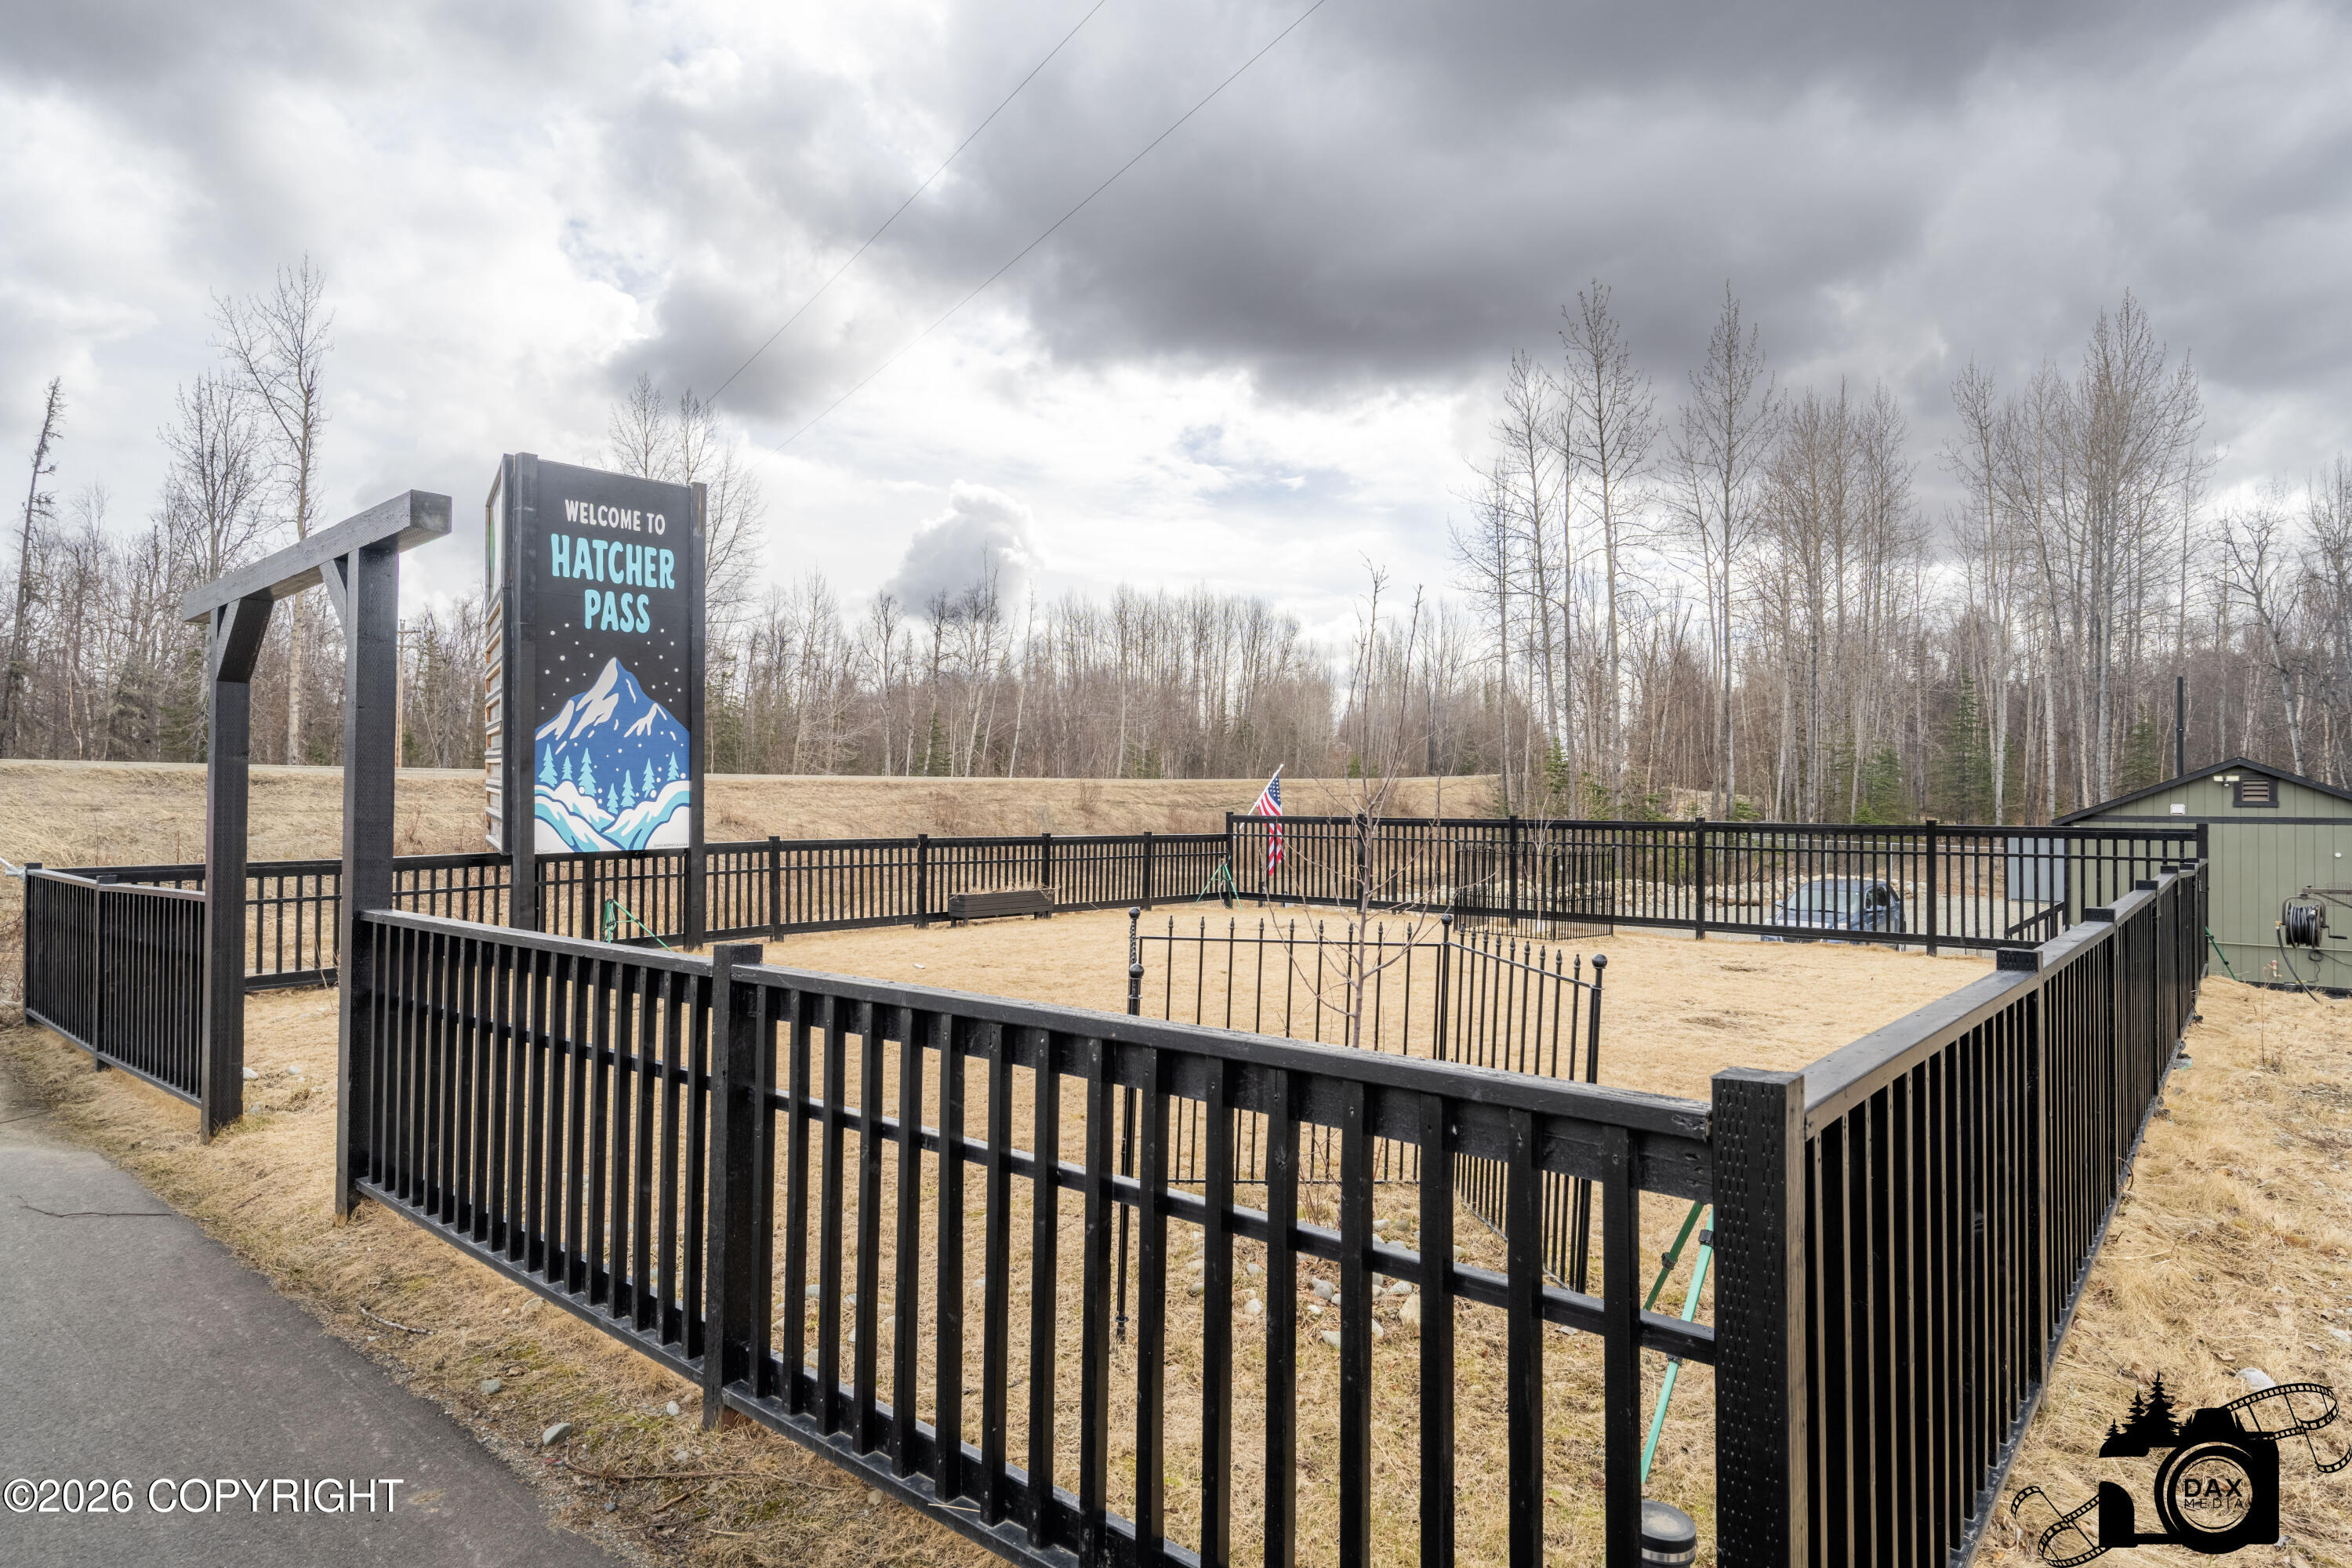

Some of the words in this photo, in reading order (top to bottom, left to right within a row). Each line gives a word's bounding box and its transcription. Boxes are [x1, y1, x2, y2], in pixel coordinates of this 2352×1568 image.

[564, 499, 641, 532] WELCOME
[646, 512, 666, 536] TO
[550, 533, 676, 590] HATCHER
[584, 589, 651, 633] PASS
